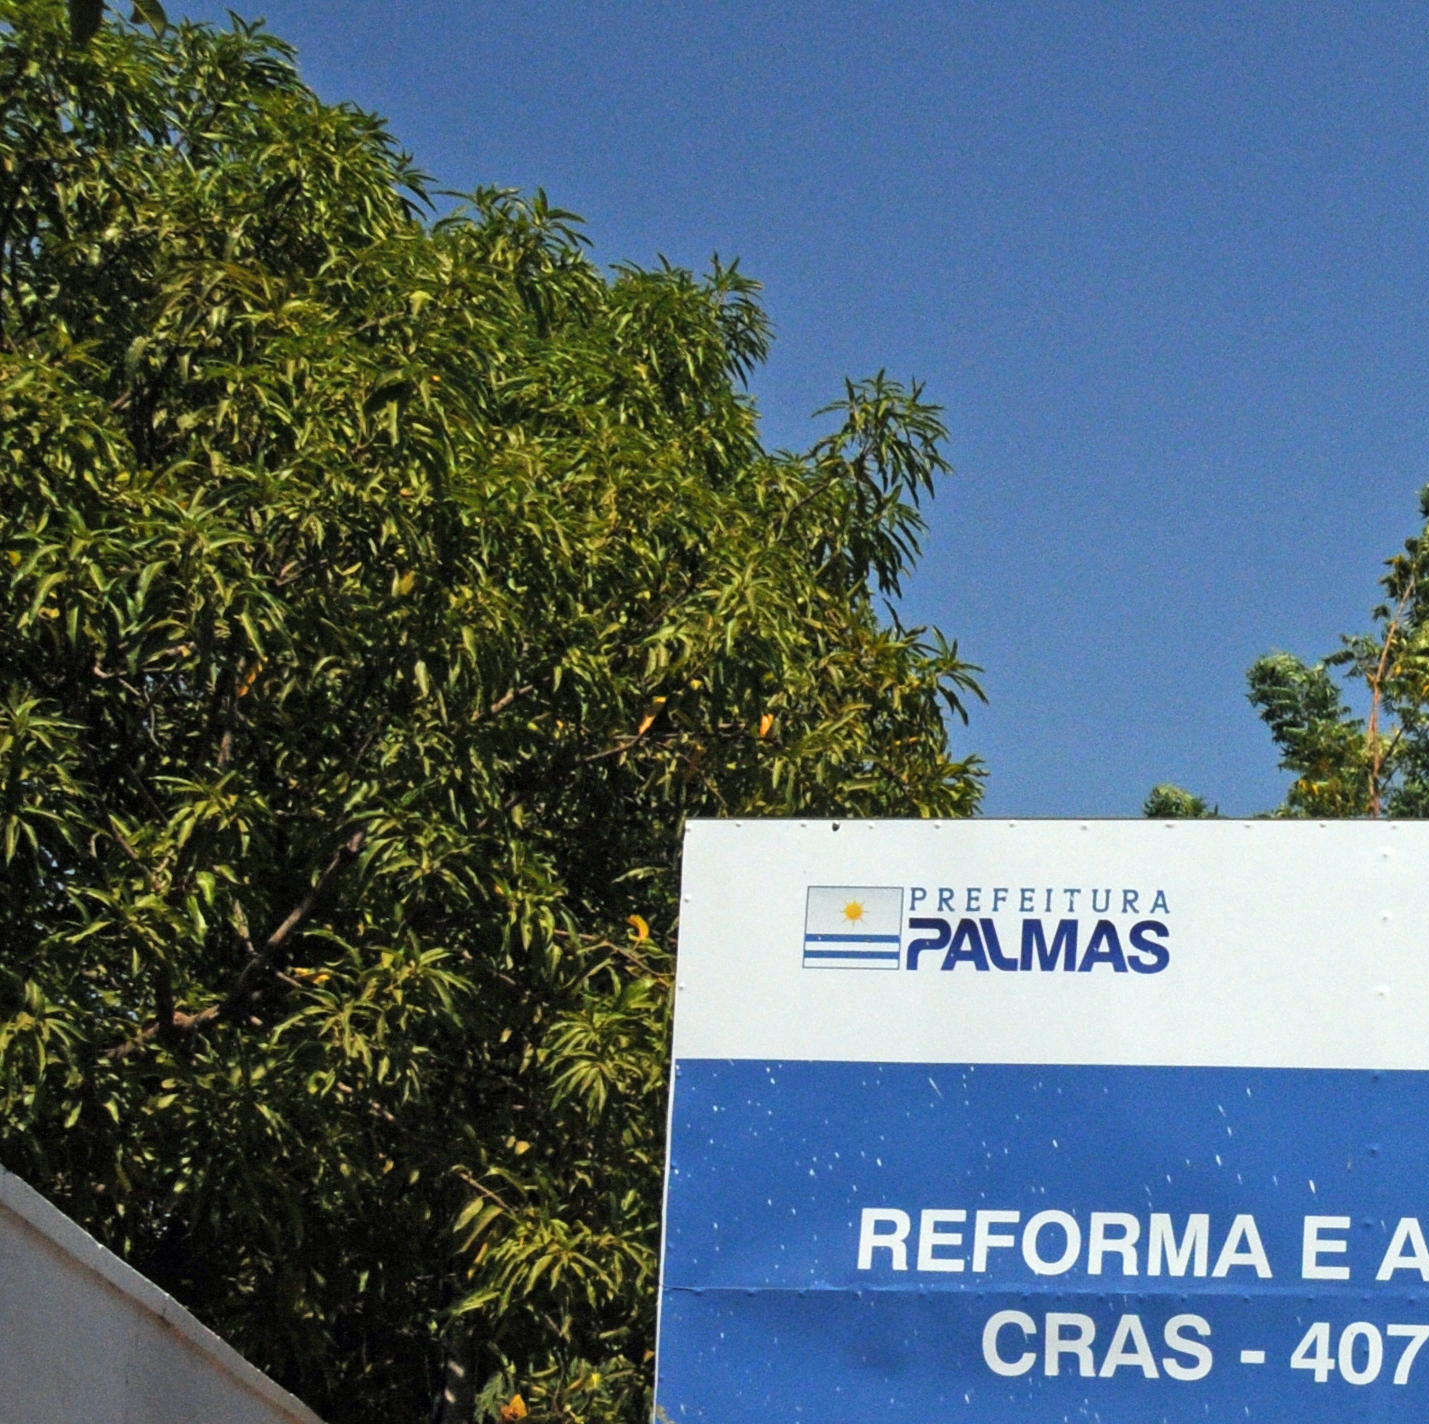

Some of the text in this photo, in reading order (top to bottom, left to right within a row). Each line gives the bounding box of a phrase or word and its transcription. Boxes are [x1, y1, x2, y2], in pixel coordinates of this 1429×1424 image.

[909, 886, 1171, 915] PREFEITURA
[905, 917, 1170, 974] PALMAS
[857, 1208, 1273, 1278] REFORMA
[1302, 1215, 1351, 1280] E
[981, 1309, 1214, 1381] CRAS
[1239, 1349, 1267, 1365] -
